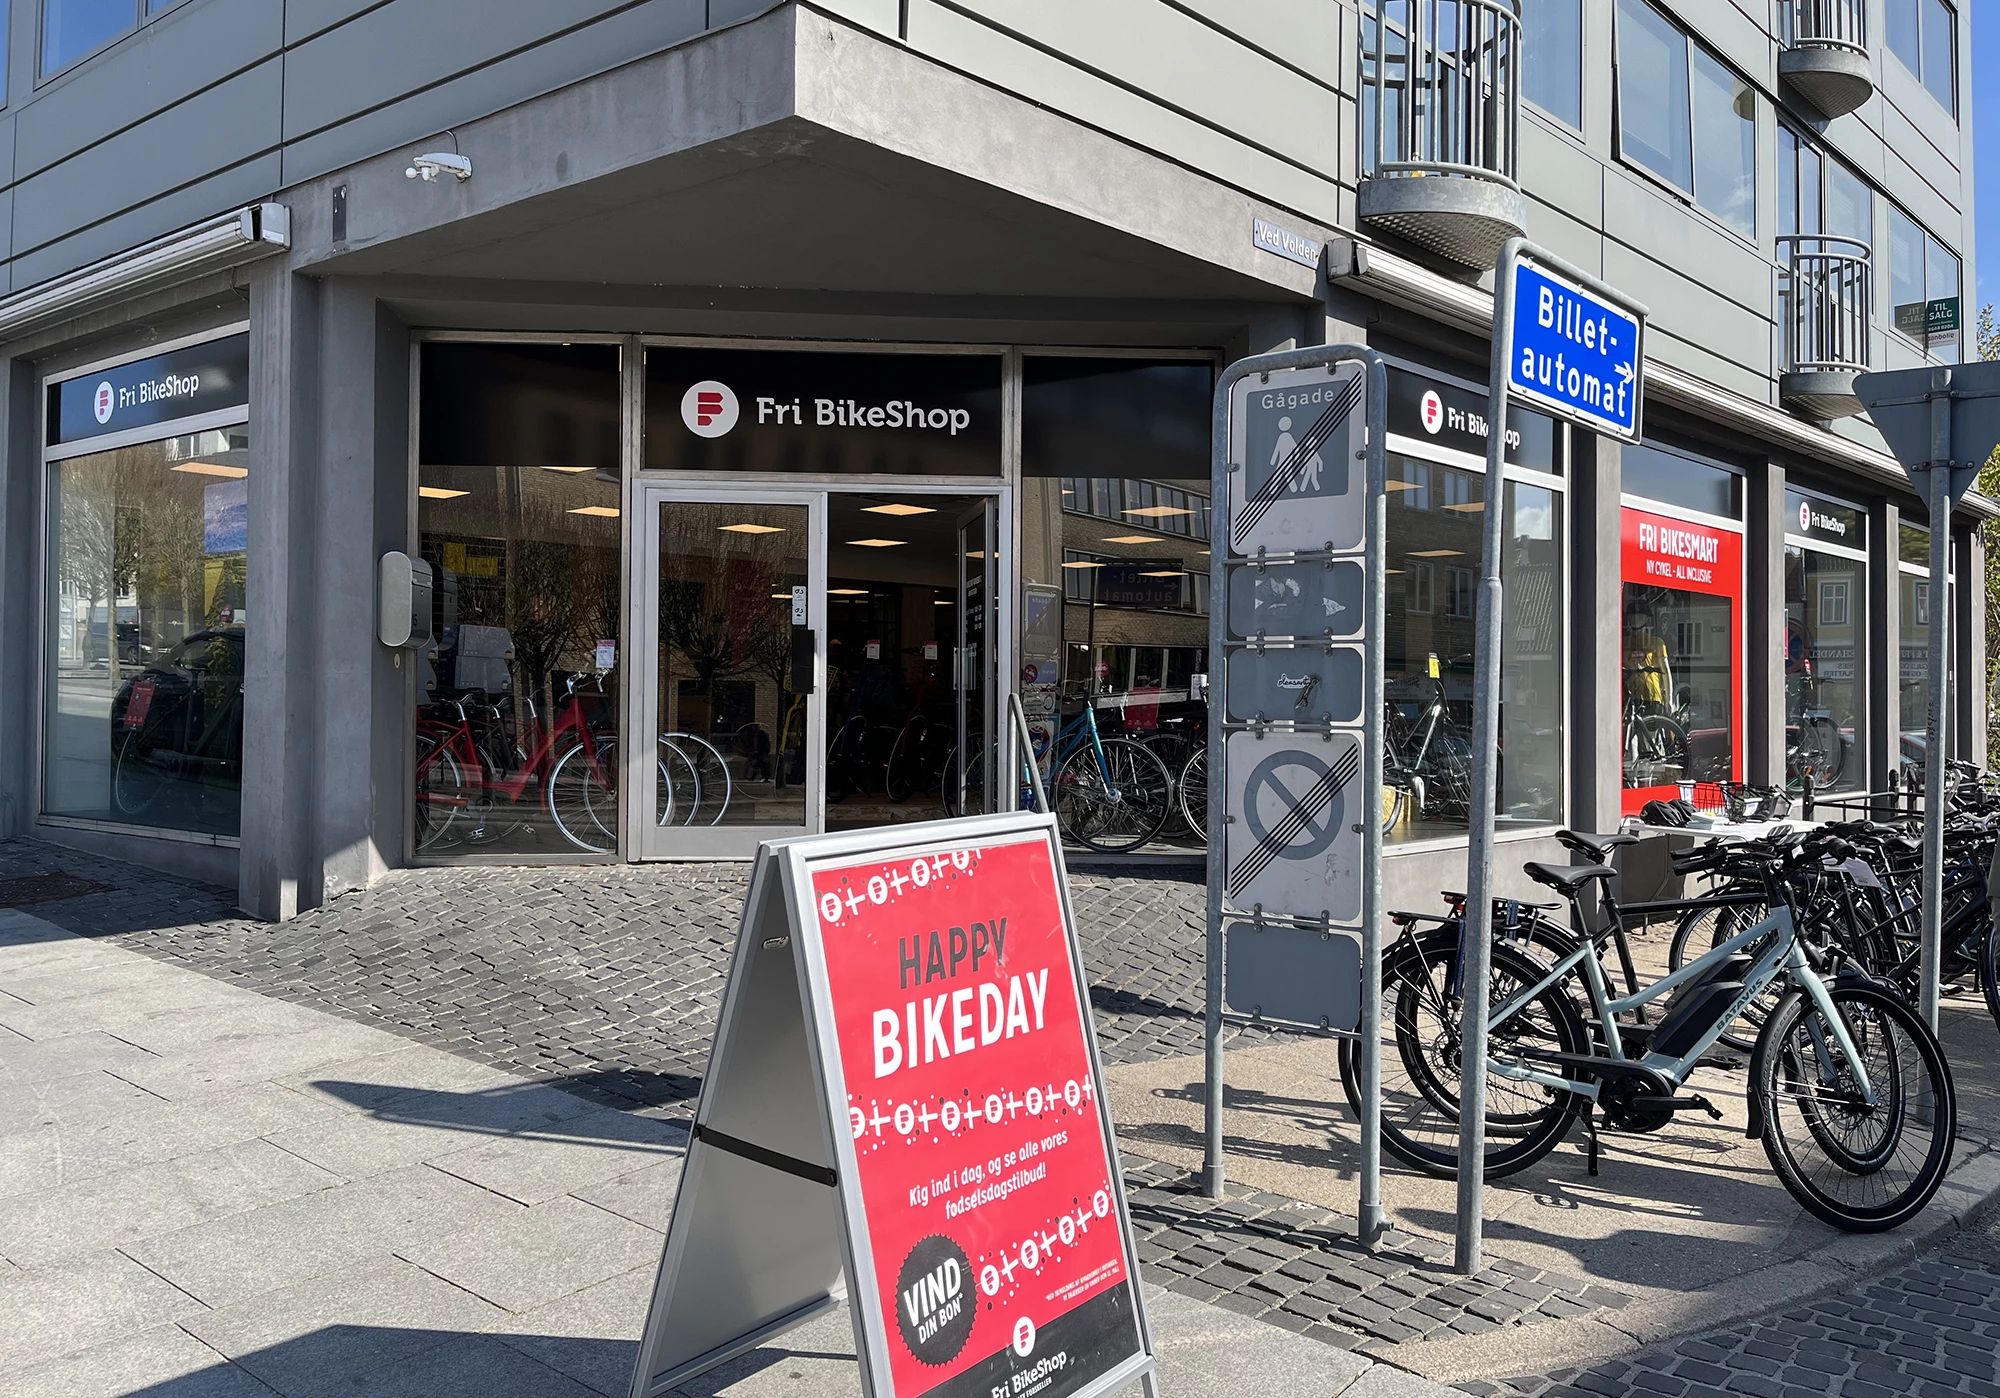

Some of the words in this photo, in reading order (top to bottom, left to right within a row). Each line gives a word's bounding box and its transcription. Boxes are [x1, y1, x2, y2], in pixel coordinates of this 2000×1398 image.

[1258, 222, 1279, 247] Ved
[1281, 231, 1316, 262] Volden
[1538, 285, 1617, 356] Billet-
[1928, 309, 1953, 321] SALG
[1934, 302, 1948, 311] TIL
[118, 384, 136, 409] Fri
[139, 374, 200, 404] BikeShop
[1261, 387, 1334, 409] Gågade
[1521, 347, 1626, 418] automat
[756, 397, 802, 425] Fri
[814, 398, 970, 436] BikeShop
[1447, 406, 1465, 432] Fri
[1467, 412, 1520, 451] Bikop
[1639, 522, 1657, 553] FRI
[1660, 527, 1719, 564] BIKESMART
[1811, 511, 1820, 528] Fri
[1820, 513, 1846, 537] BikeShop
[1646, 559, 1655, 574] NY
[1655, 561, 1672, 578] CYKEL
[1676, 564, 1686, 580] ALL
[1686, 566, 1712, 584] INCLUSIVE
[899, 917, 1007, 990] HAPPY
[873, 967, 1049, 1080] BIKEDAY
[1716, 978, 1763, 1031] BATAVUS
[909, 1184, 929, 1207] Kig
[931, 1173, 951, 1198] ind
[953, 1170, 958, 1189] i
[961, 1164, 986, 1184] dag,
[987, 1156, 1001, 1177] og
[1004, 1151, 1017, 1168] se
[1019, 1141, 1039, 1162] alle
[1040, 1130, 1069, 1153] vores
[903, 1257, 962, 1328] VIND
[918, 1314, 938, 1345] DIN
[991, 1380, 1011, 1398] Fri
[1012, 1351, 1067, 1394] BikeShop
